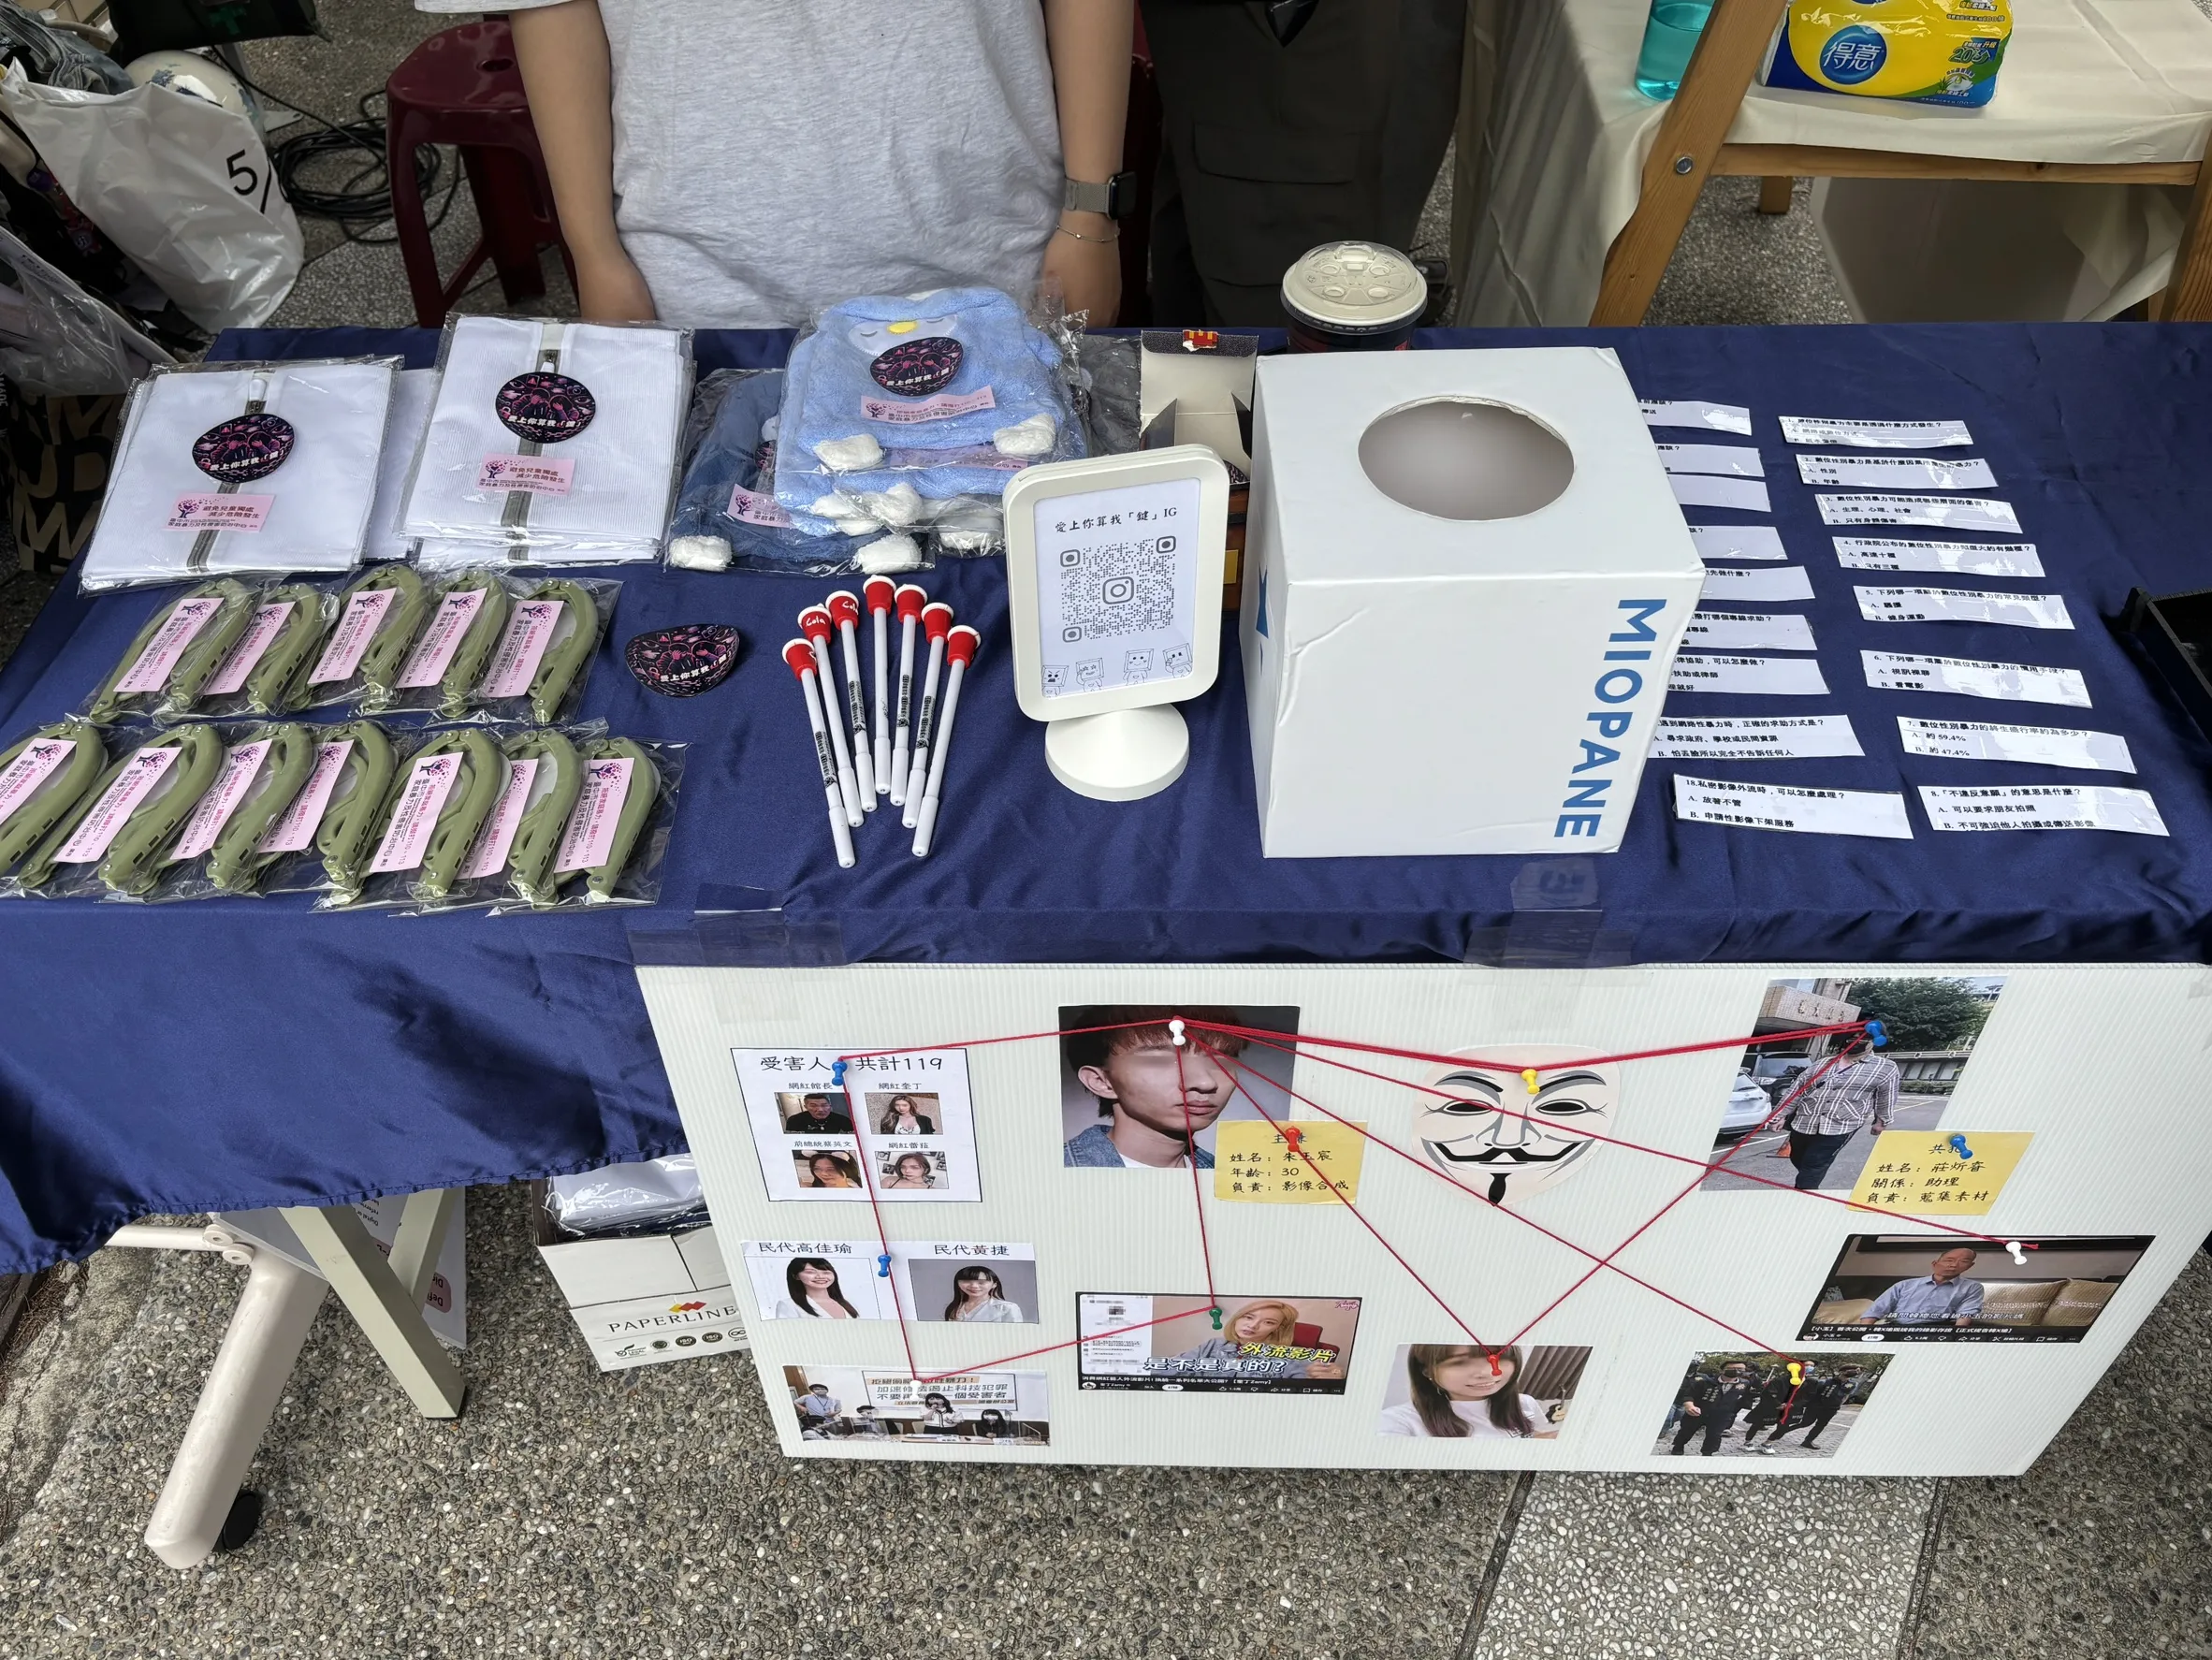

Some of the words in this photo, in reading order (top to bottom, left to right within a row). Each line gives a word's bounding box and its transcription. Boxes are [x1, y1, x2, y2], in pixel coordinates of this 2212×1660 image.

[1824, 42, 1880, 70] 得意
[806, 615, 826, 627] Cola
[1691, 613, 1772, 622] 撥打哪個專線求助？
[1674, 656, 1766, 666] 律協助，可以怎麼做？
[1554, 599, 1666, 837] MIOPANE
[1938, 734, 1967, 742] 59.4%
[1941, 749, 1971, 757] 47.4%
[1702, 795, 1742, 807] 放著不管
[1952, 805, 2037, 813] 可以要求朋友拍照
[760, 1056, 831, 1072] 受害人
[854, 1056, 943, 1071] 共計119
[788, 1082, 834, 1090] 網紅館長
[878, 1082, 923, 1090] 網紅奎丁
[793, 1140, 853, 1148] 前總統蔡英文
[758, 1242, 852, 1255] 民代高佳瑜
[934, 1244, 1010, 1257] 民代黃捷
[608, 1305, 736, 1333] PAPERLINE
[1238, 1342, 1336, 1362] 外流影片
